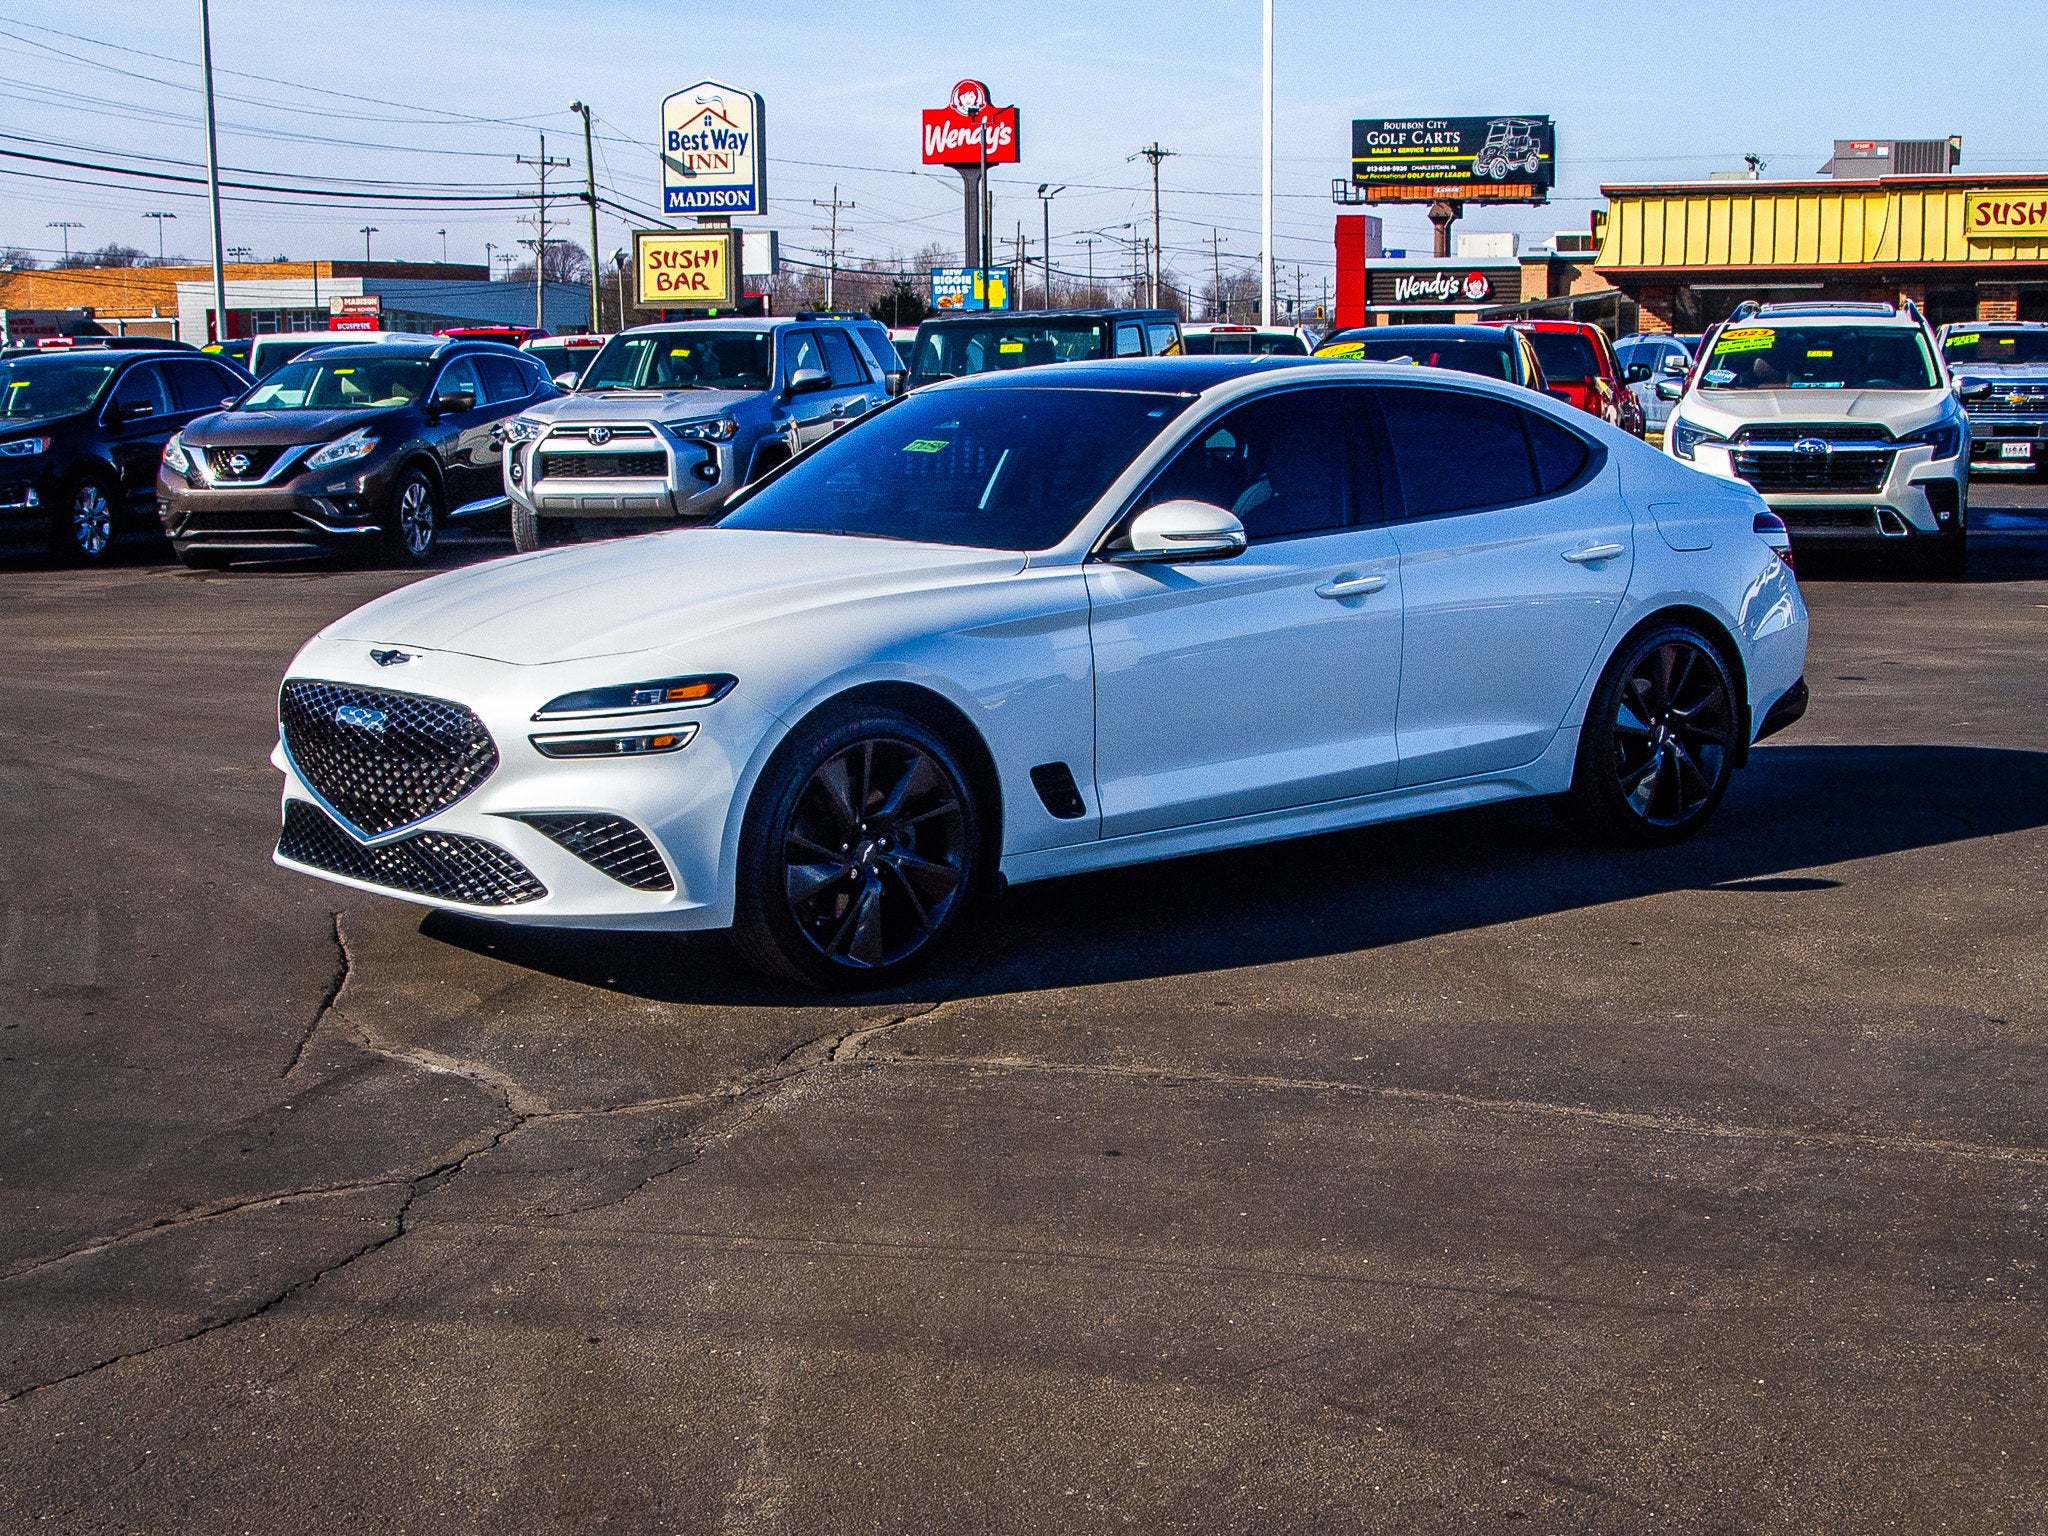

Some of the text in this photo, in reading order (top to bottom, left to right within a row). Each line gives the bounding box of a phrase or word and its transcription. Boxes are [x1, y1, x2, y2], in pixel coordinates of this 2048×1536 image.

[1383, 120, 1447, 130] BOURBON CITY
[668, 128, 749, 156] Best Way
[925, 116, 1012, 156] Wendy's
[1366, 130, 1461, 145] GOLF CARTS
[1397, 146, 1424, 154] SERVICE
[687, 153, 729, 170] INN
[669, 190, 750, 208] MADISON
[649, 249, 718, 270] SUSHI
[656, 271, 710, 291] BAR
[1394, 271, 1460, 301] Wendy's
